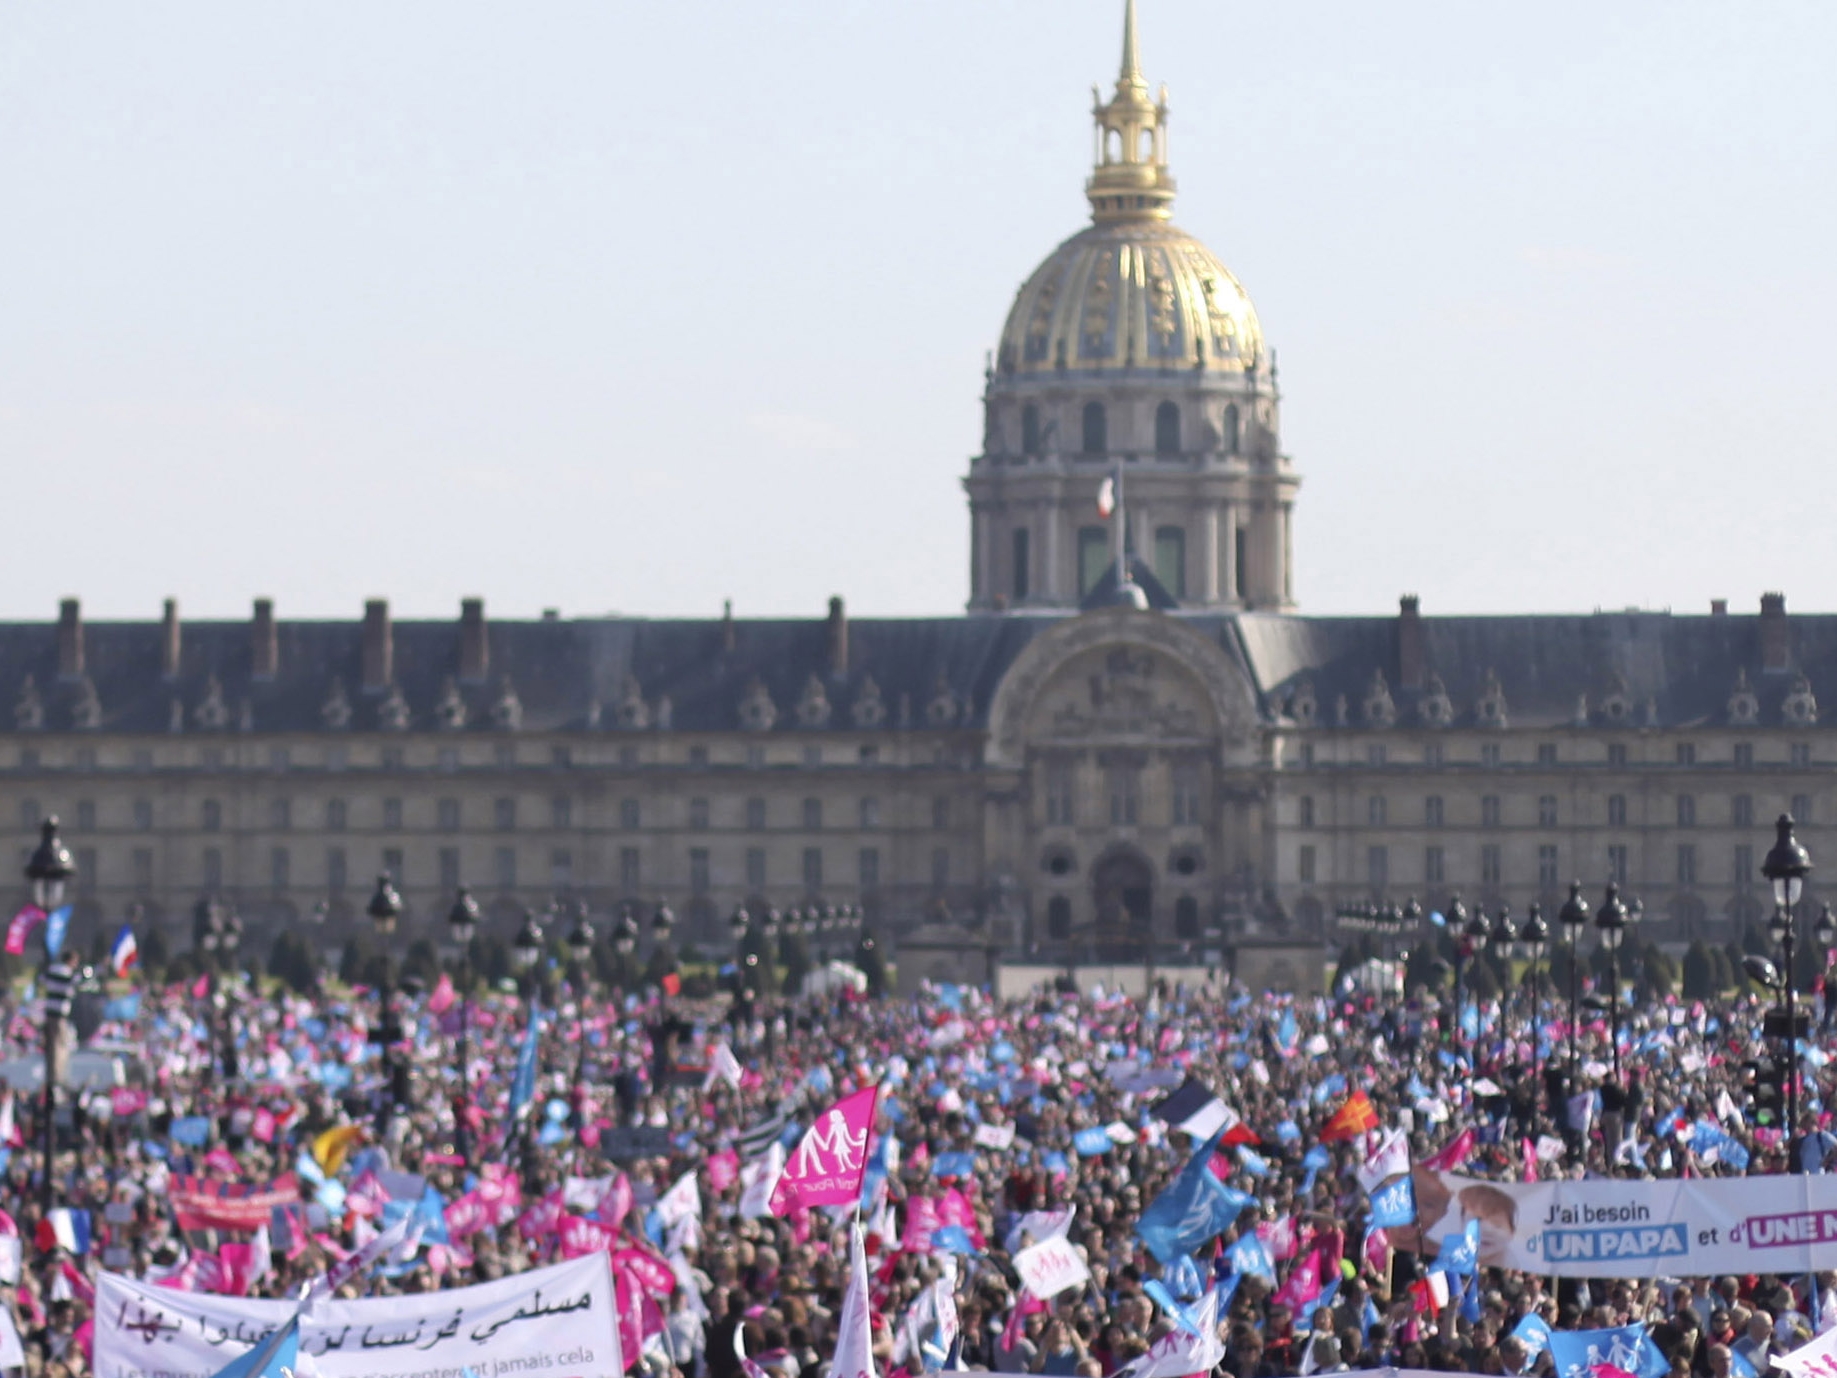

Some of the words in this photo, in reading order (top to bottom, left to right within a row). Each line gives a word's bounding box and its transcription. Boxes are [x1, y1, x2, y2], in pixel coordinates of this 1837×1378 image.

[1543, 1204, 1579, 1225] J'ai
[1583, 1200, 1650, 1224] besoin
[1526, 1231, 1594, 1259] d'UN
[1599, 1226, 1684, 1257] PAPA
[1697, 1227, 1719, 1246] et
[1729, 1213, 1818, 1245] d'UNE
[494, 1352, 554, 1377] jamais
[558, 1347, 595, 1366] cela
